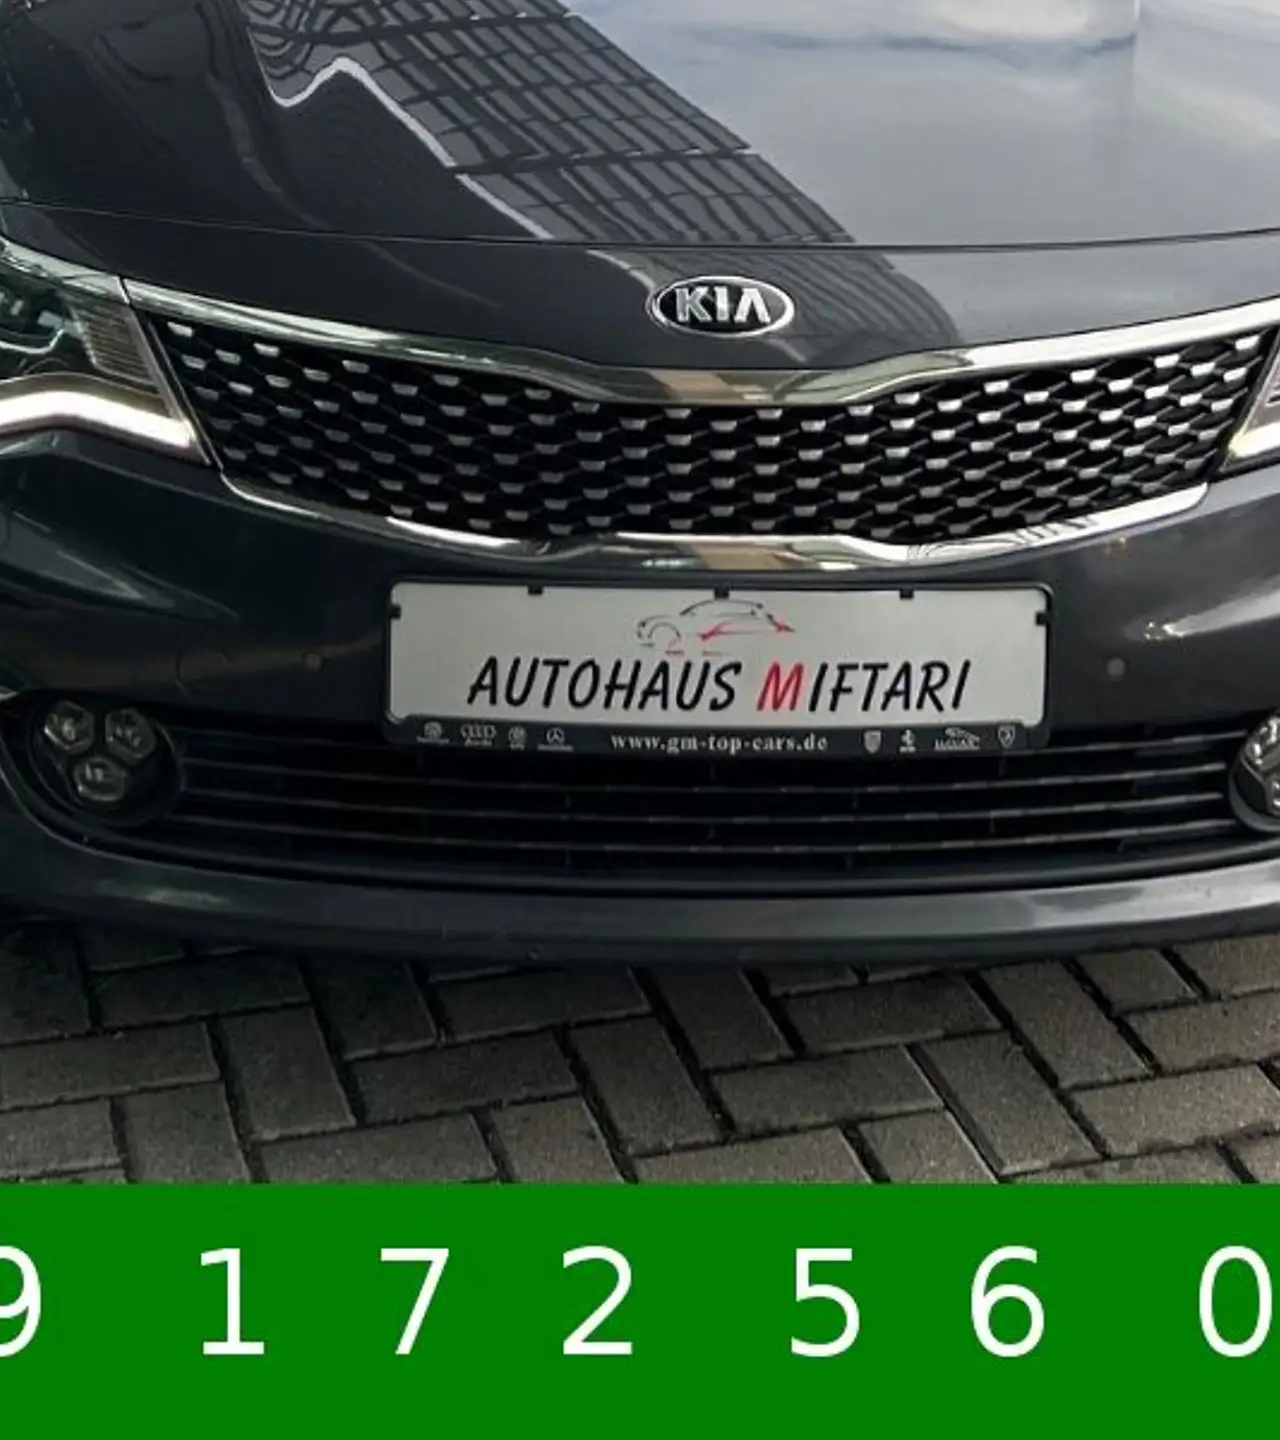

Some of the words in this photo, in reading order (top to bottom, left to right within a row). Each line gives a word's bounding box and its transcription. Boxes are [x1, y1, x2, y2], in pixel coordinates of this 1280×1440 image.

[675, 285, 771, 324] KIA
[466, 656, 743, 712] AUTOHAUS
[756, 659, 972, 713] MIFTARI
[609, 732, 829, 755] www.gm-top-cars.de
